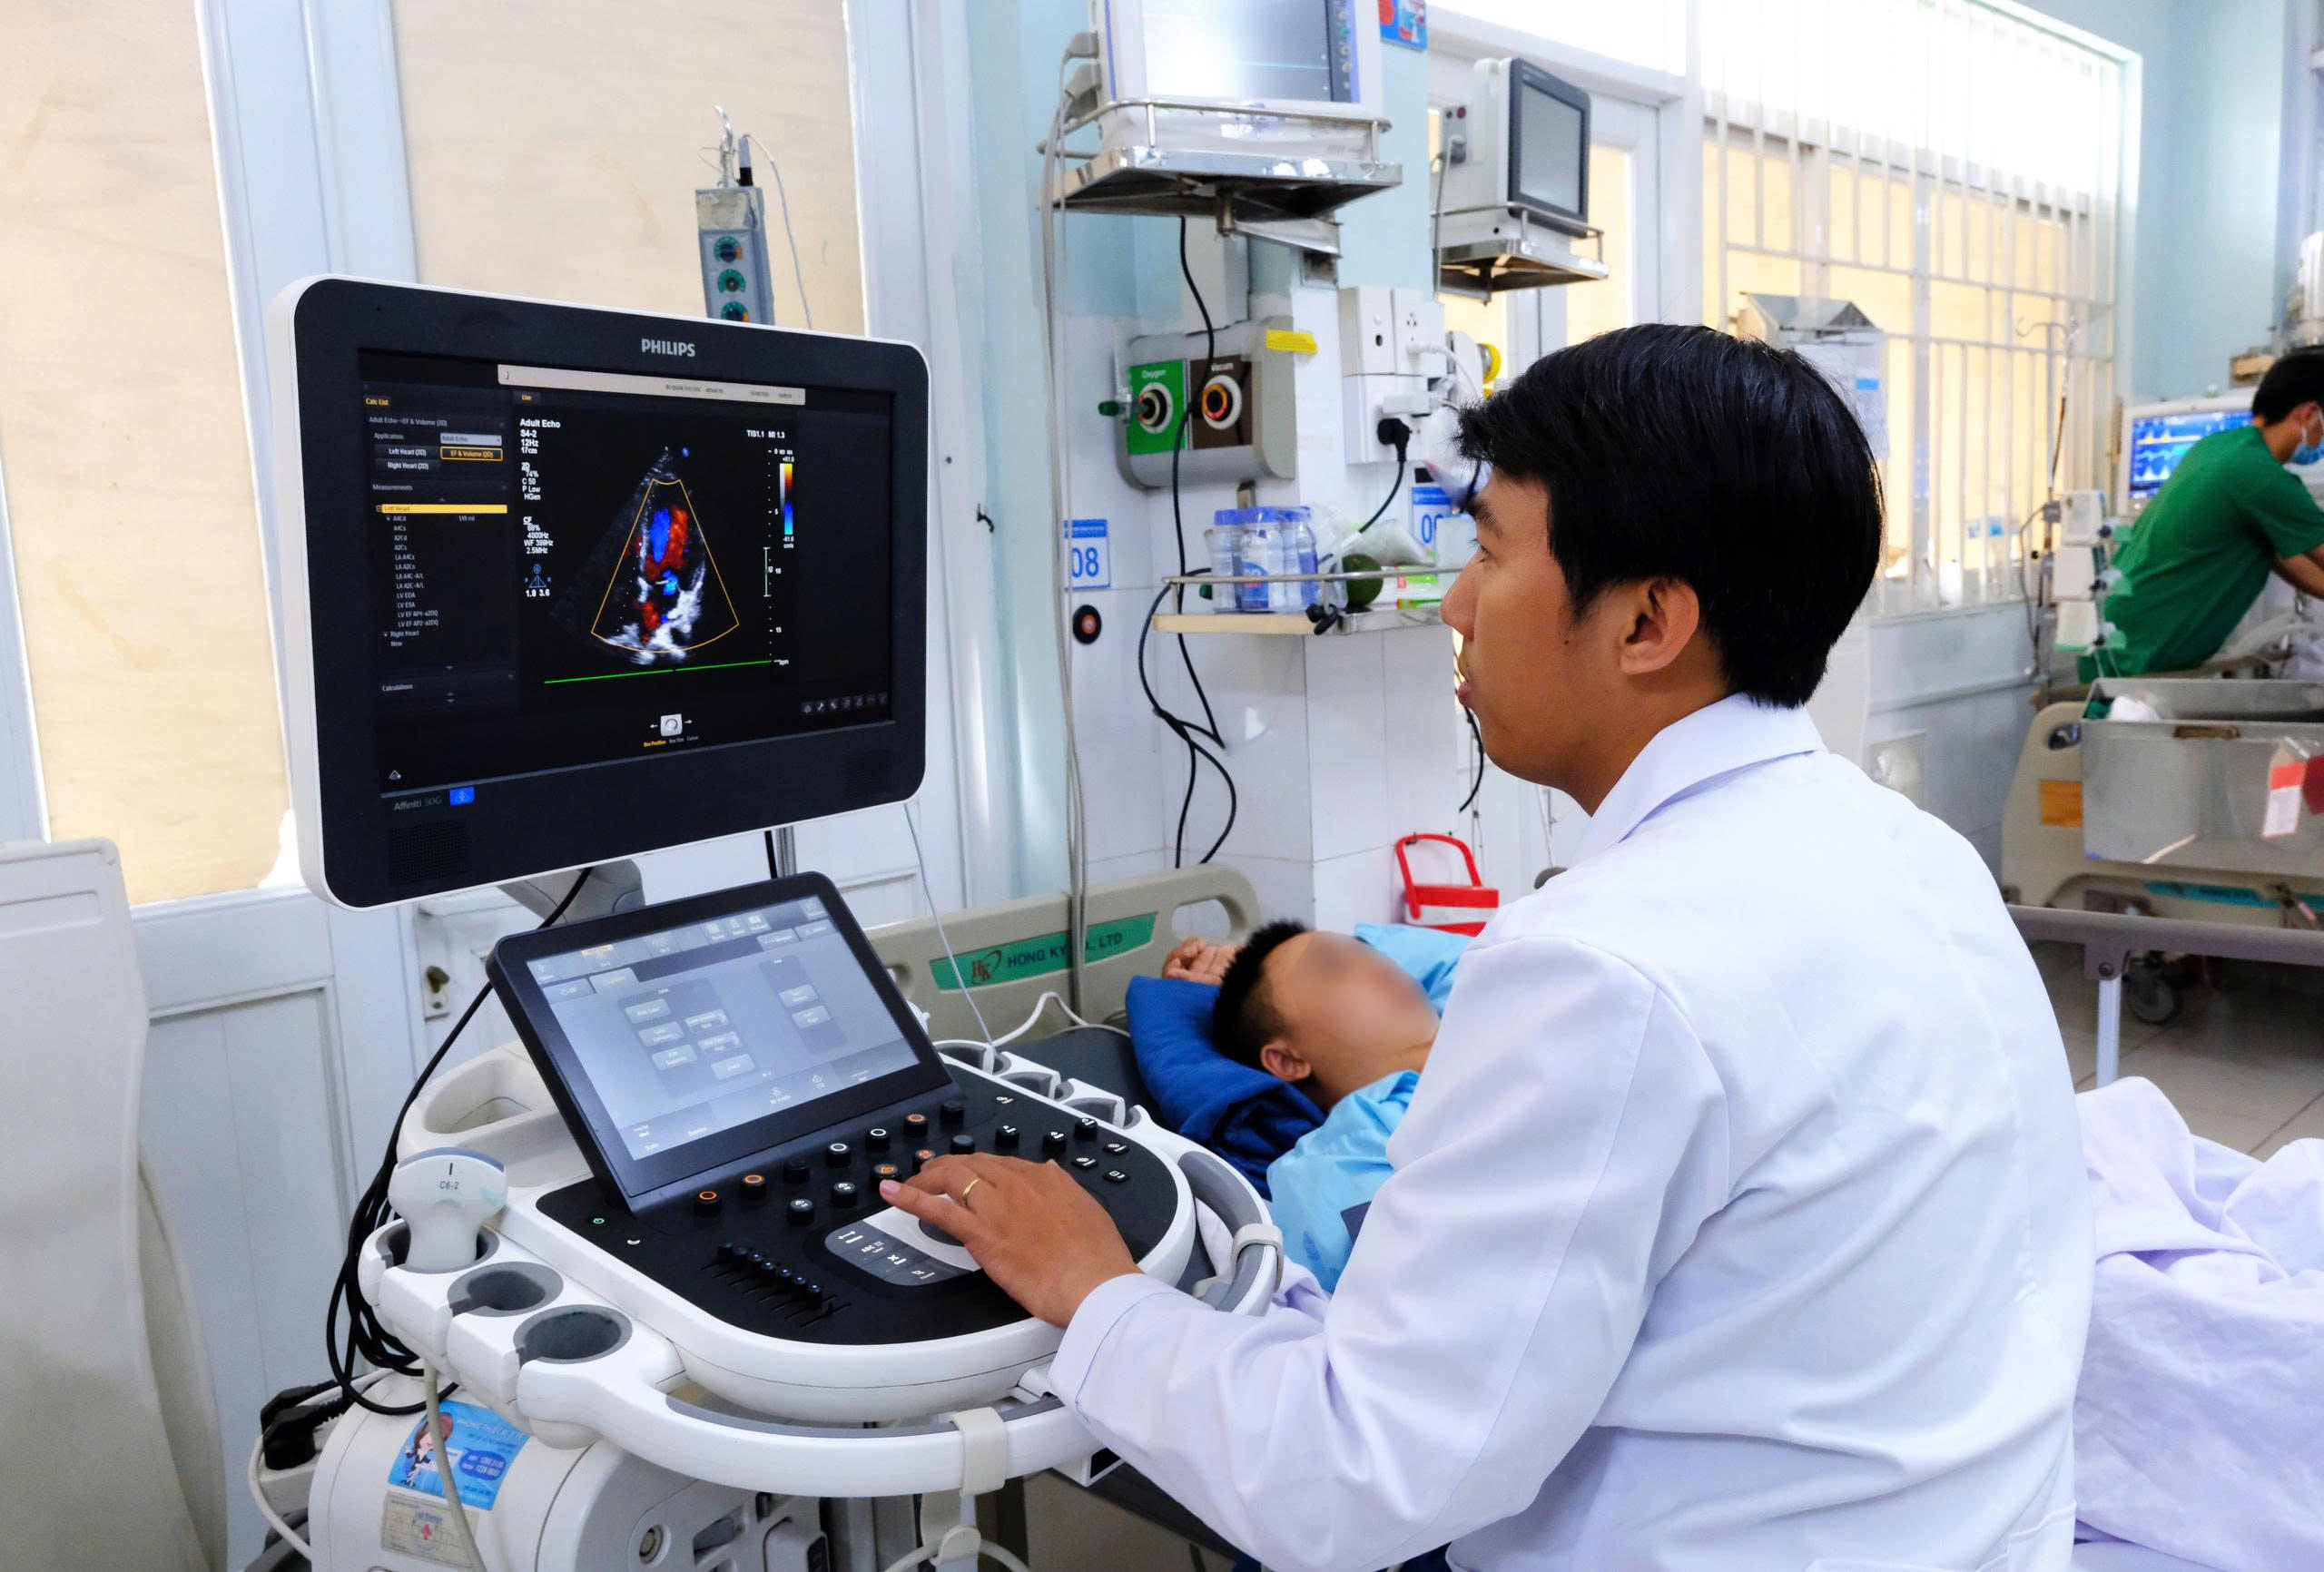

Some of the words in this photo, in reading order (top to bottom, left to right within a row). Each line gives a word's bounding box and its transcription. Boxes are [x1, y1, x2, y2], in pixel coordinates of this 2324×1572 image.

[641, 338, 696, 357] PHILIPS
[520, 418, 540, 427] Adult
[542, 419, 561, 428] Echo
[520, 429, 537, 438] S4-2
[521, 439, 539, 447] 12Hz
[387, 462, 402, 470] Right
[1422, 514, 1443, 543] 0
[1071, 546, 1099, 578] 08
[539, 589, 550, 597] 3.6
[393, 799, 422, 811] Affiniti
[1007, 949, 1045, 968] HONG
[1098, 932, 1123, 948] LTD
[439, 1180, 459, 1190] C6-2
